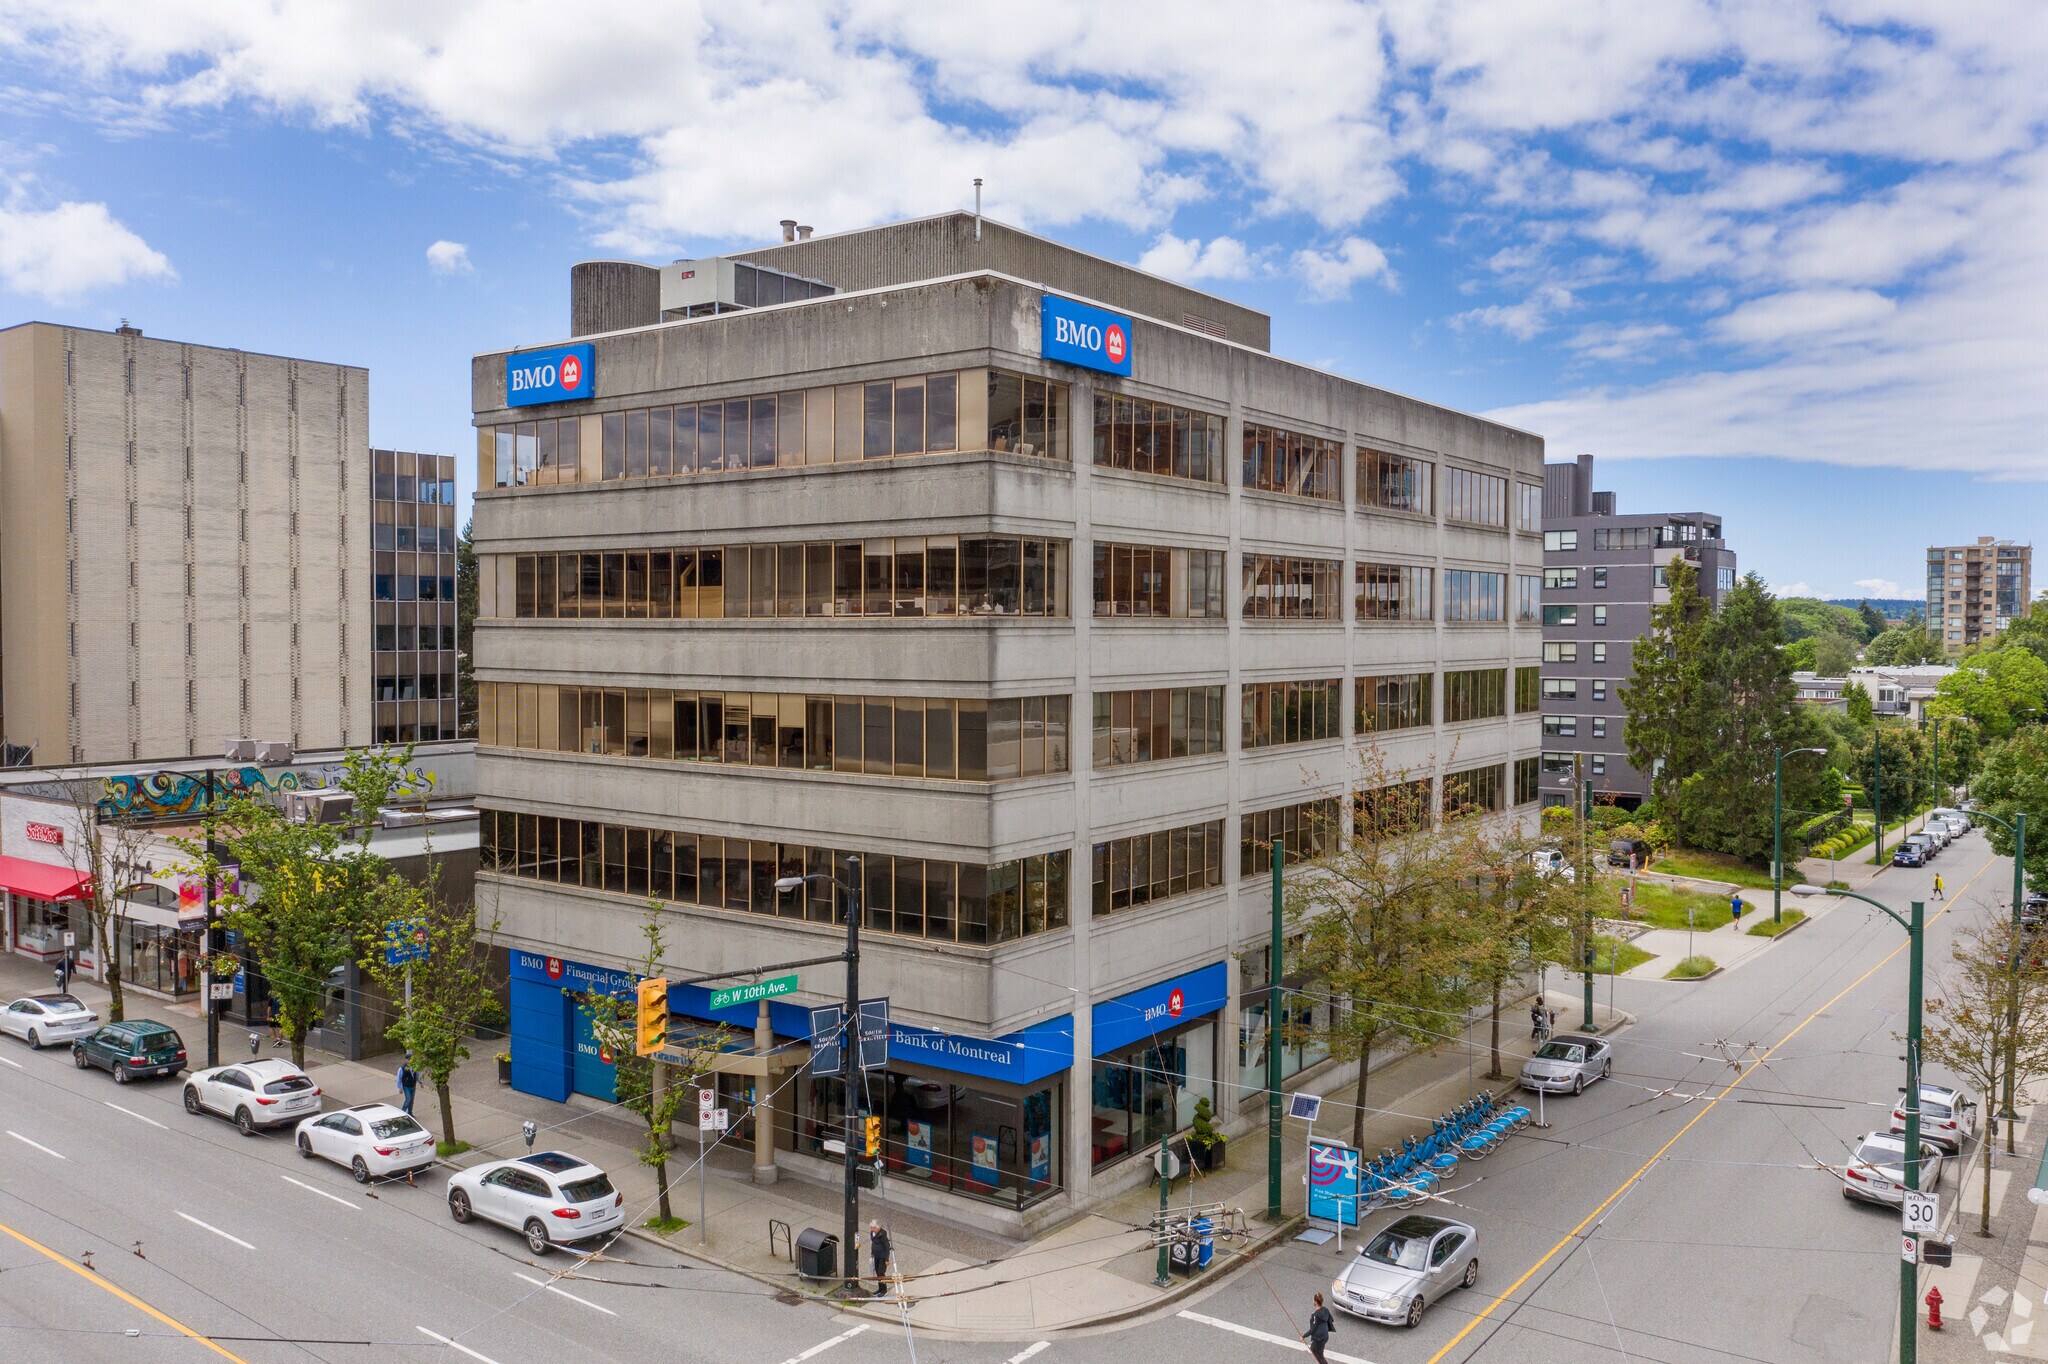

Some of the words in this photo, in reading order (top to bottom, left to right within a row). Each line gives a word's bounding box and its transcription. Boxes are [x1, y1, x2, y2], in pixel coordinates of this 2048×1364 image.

[1055, 316, 1102, 351] BMO
[512, 364, 556, 391] BMO
[520, 955, 543, 970] BMO
[566, 965, 608, 984] Financial
[732, 990, 742, 1002] W
[743, 985, 766, 1000] 10th
[767, 982, 788, 995] Ave.
[1145, 1003, 1166, 1021] BMO
[862, 1034, 888, 1042] RANVILLE
[895, 1030, 929, 1049] Bank
[931, 1039, 945, 1052] of
[948, 1041, 1011, 1065] Montreal
[577, 1043, 598, 1055] BMO
[653, 1051, 696, 1066] Granvil
[1909, 1203, 1933, 1223] 30
